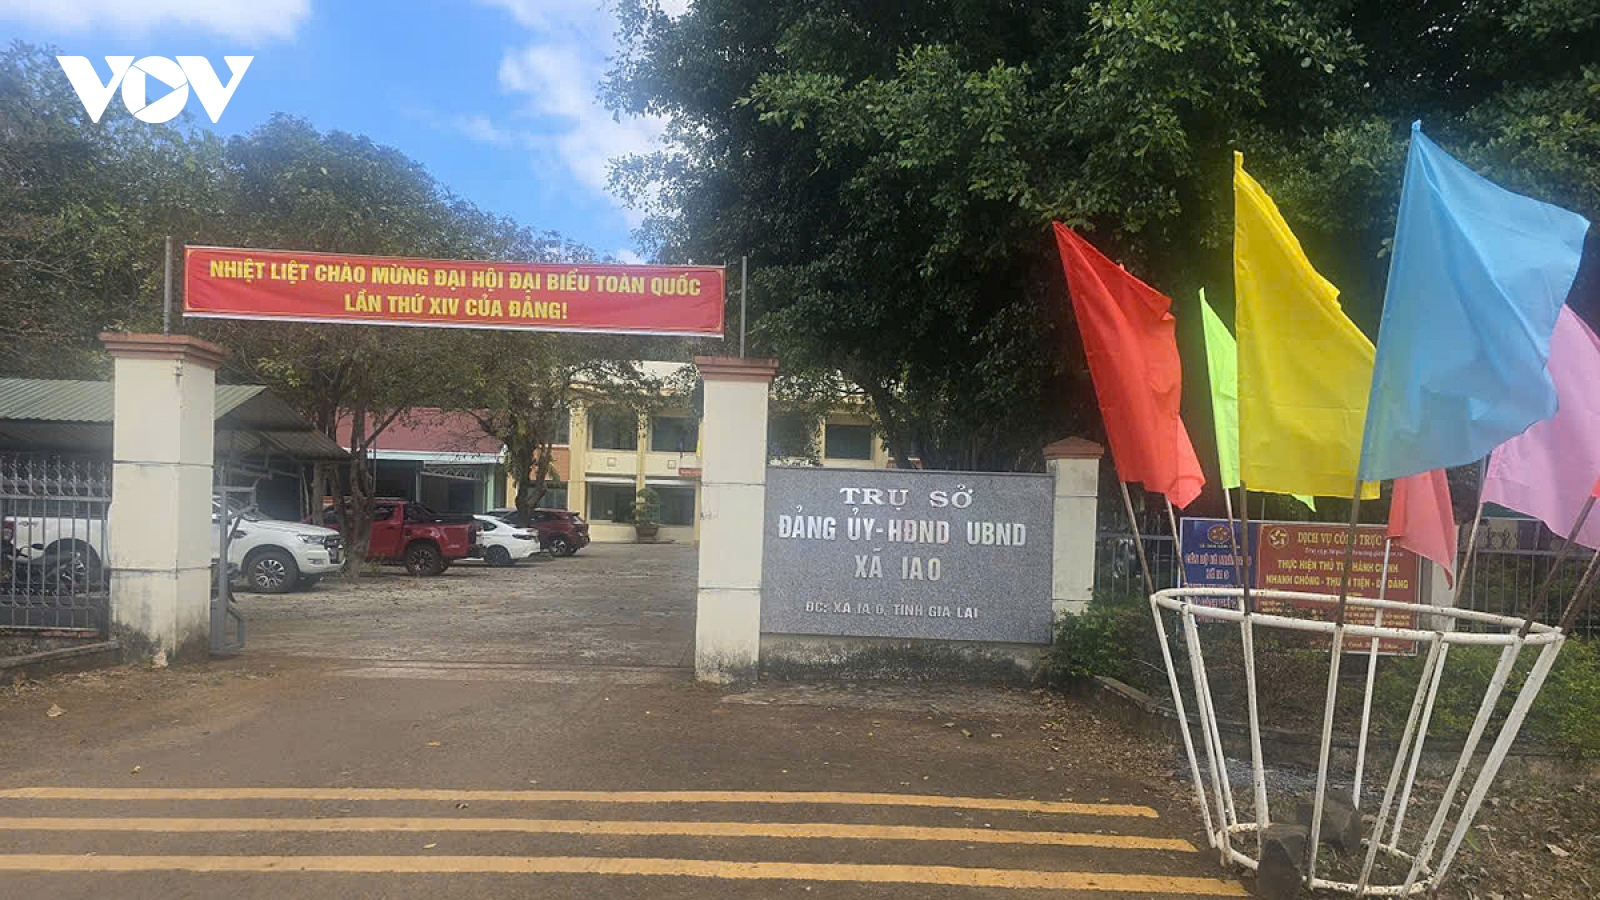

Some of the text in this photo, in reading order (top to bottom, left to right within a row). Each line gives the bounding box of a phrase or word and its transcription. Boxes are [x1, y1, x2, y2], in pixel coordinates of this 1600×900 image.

[210, 259, 701, 297] NHIỆT LIỆT CHÀO MỪNG ĐẠI HỘI ĐẠI BIỂU TOÀN QUỐC
[345, 288, 568, 320] LẦN THỨ XIV CỦA ĐẢNG!
[839, 484, 974, 511] TRỤ SỞ
[778, 505, 836, 541] ĐẢNG
[967, 521, 1026, 546] UBND
[1298, 531, 1319, 545] DỊCH
[1320, 532, 1332, 546] VỤ
[1360, 533, 1381, 548] TRỰC
[854, 547, 883, 579] XÃ
[1299, 558, 1317, 572] HIỆN
[1266, 575, 1293, 585] NHANH
[928, 605, 950, 617] GIA
[957, 606, 978, 619] LAI
